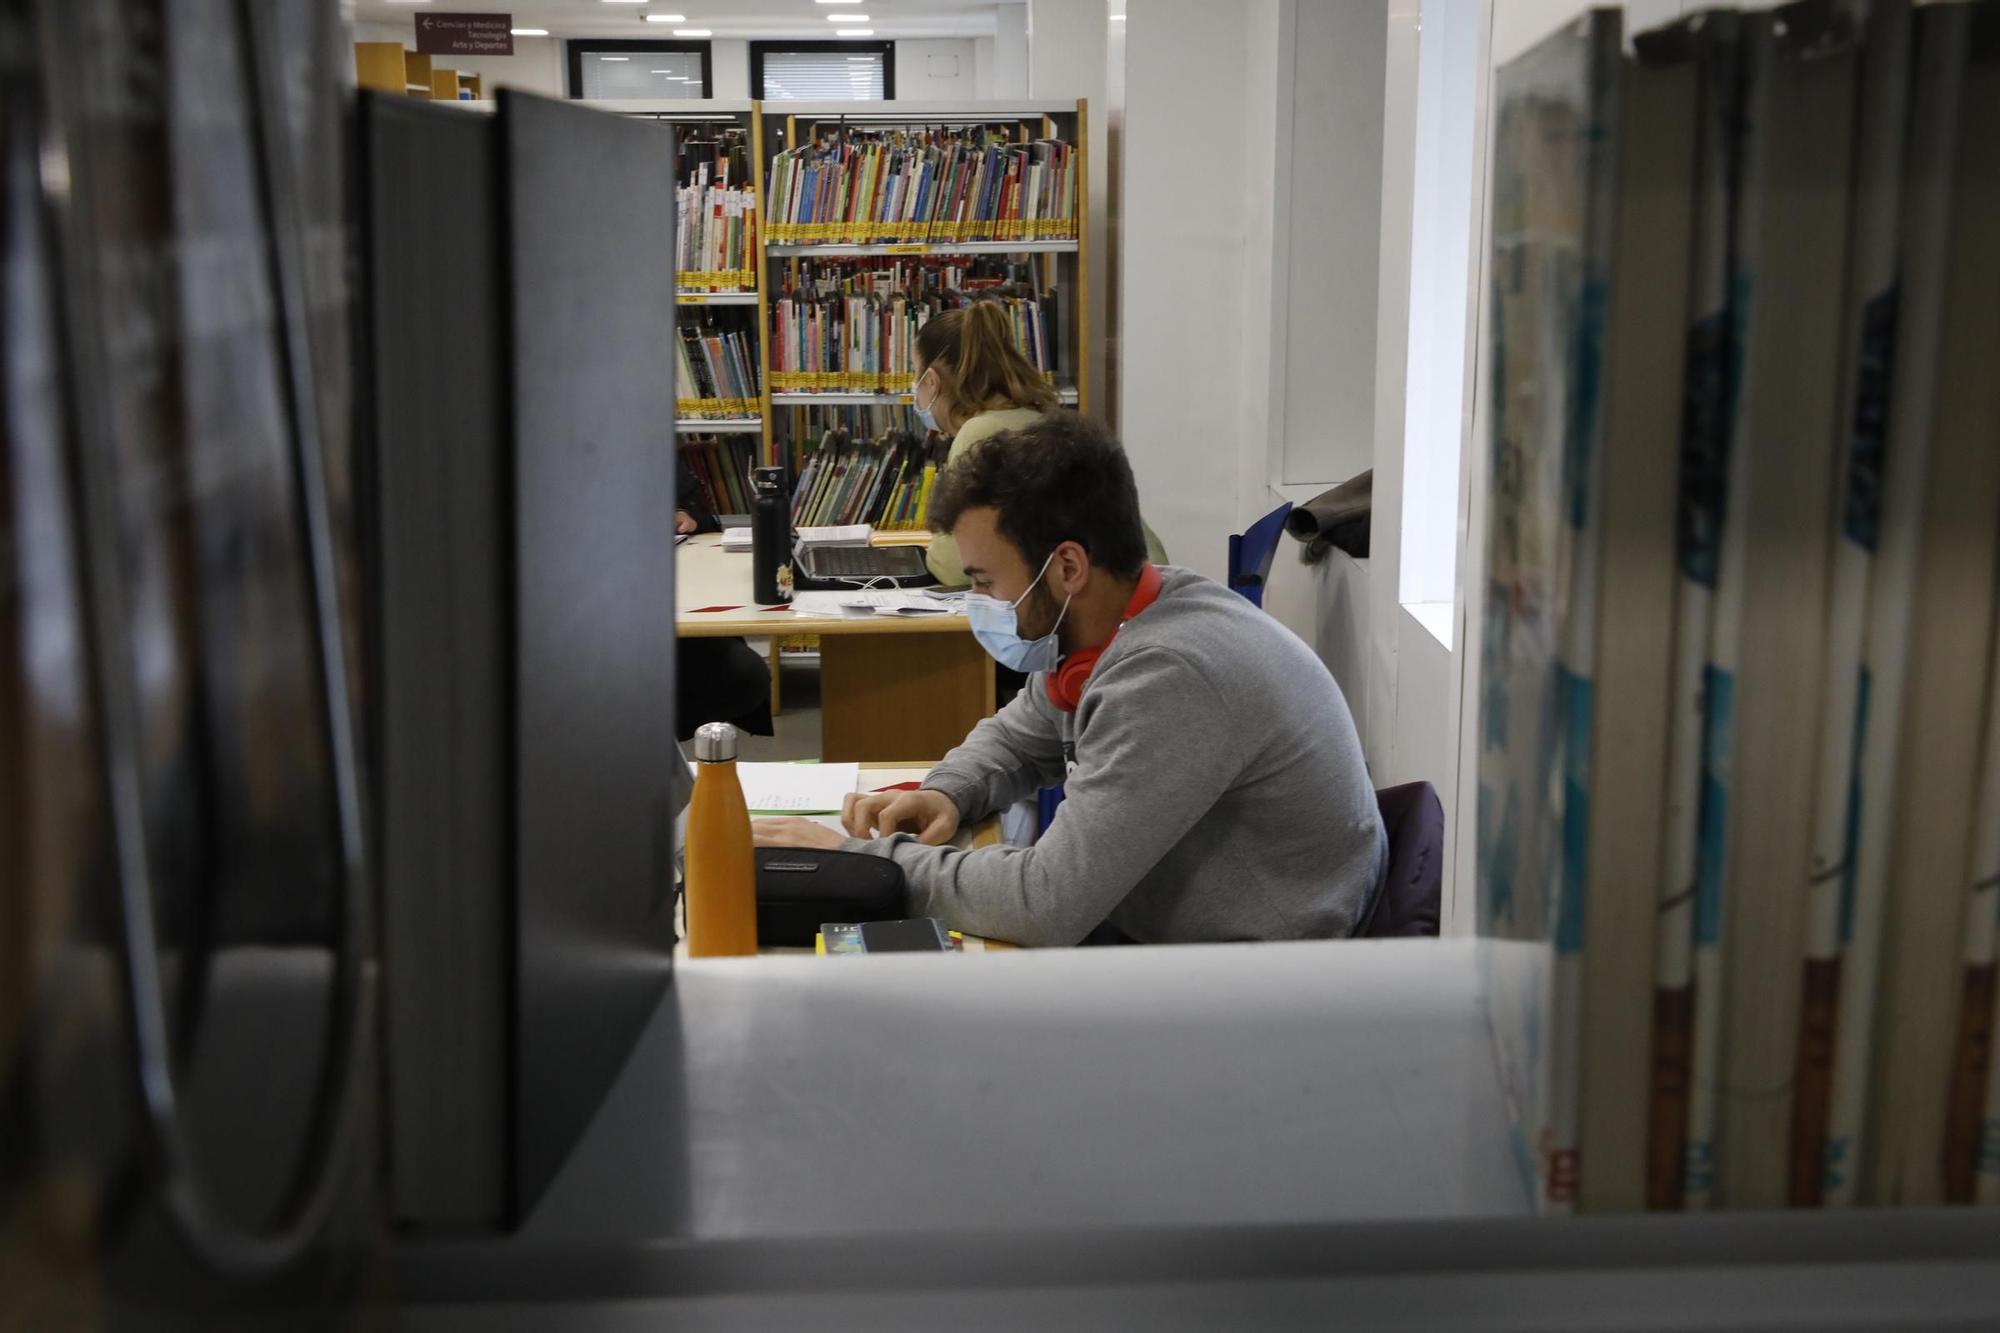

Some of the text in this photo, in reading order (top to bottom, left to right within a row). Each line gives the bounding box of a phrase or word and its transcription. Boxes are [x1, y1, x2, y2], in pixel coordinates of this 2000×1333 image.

[473, 21, 506, 29] Medicina
[452, 41, 468, 49] Arte
[475, 41, 508, 50] Deportes
